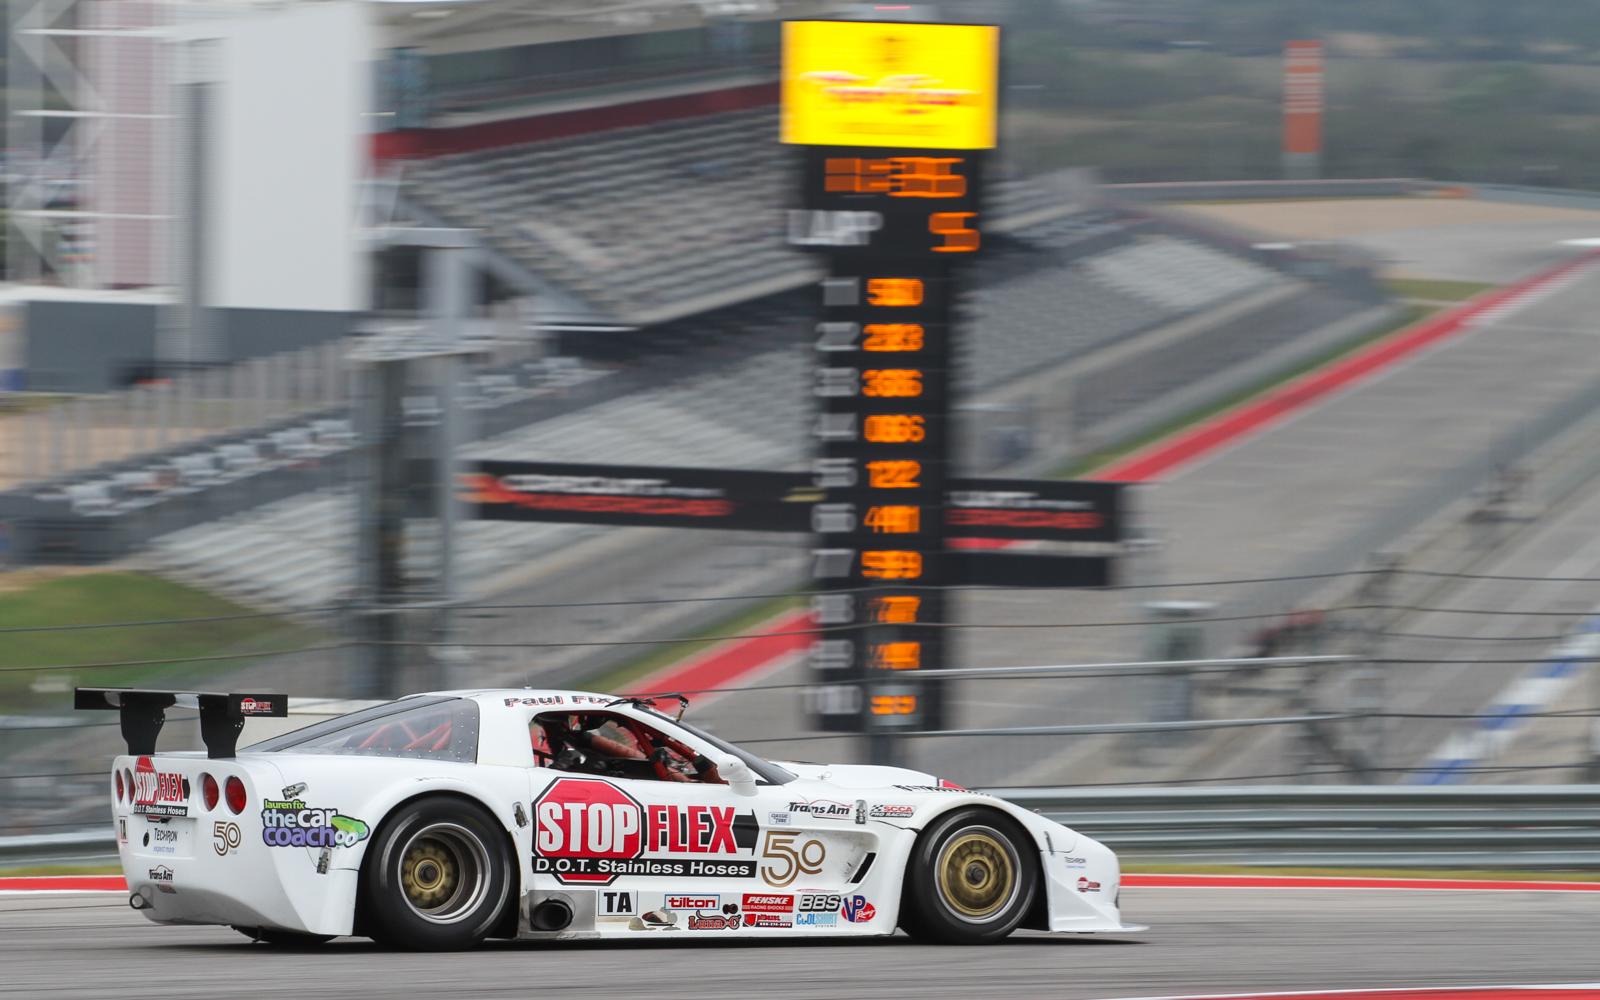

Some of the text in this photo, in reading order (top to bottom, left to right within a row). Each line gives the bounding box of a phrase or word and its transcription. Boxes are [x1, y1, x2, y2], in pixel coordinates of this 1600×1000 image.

[503, 695, 564, 708] Paul
[135, 771, 184, 802] STOP FLEX
[167, 806, 187, 816] Hoses
[264, 800, 293, 809] lauren
[788, 802, 850, 815] Trans Am
[883, 805, 913, 813] SCCA
[262, 808, 297, 828] the
[263, 826, 335, 847] coach
[538, 802, 737, 854] STOP FLEX
[213, 820, 241, 857] 50
[535, 857, 750, 876] D.O.T. Stainless Hoses
[760, 831, 826, 888] 50
[603, 892, 632, 913] TA
[668, 896, 716, 908] tilton
[747, 895, 790, 905] PENSKE
[799, 894, 841, 912] BBS
[843, 895, 866, 923] VP
